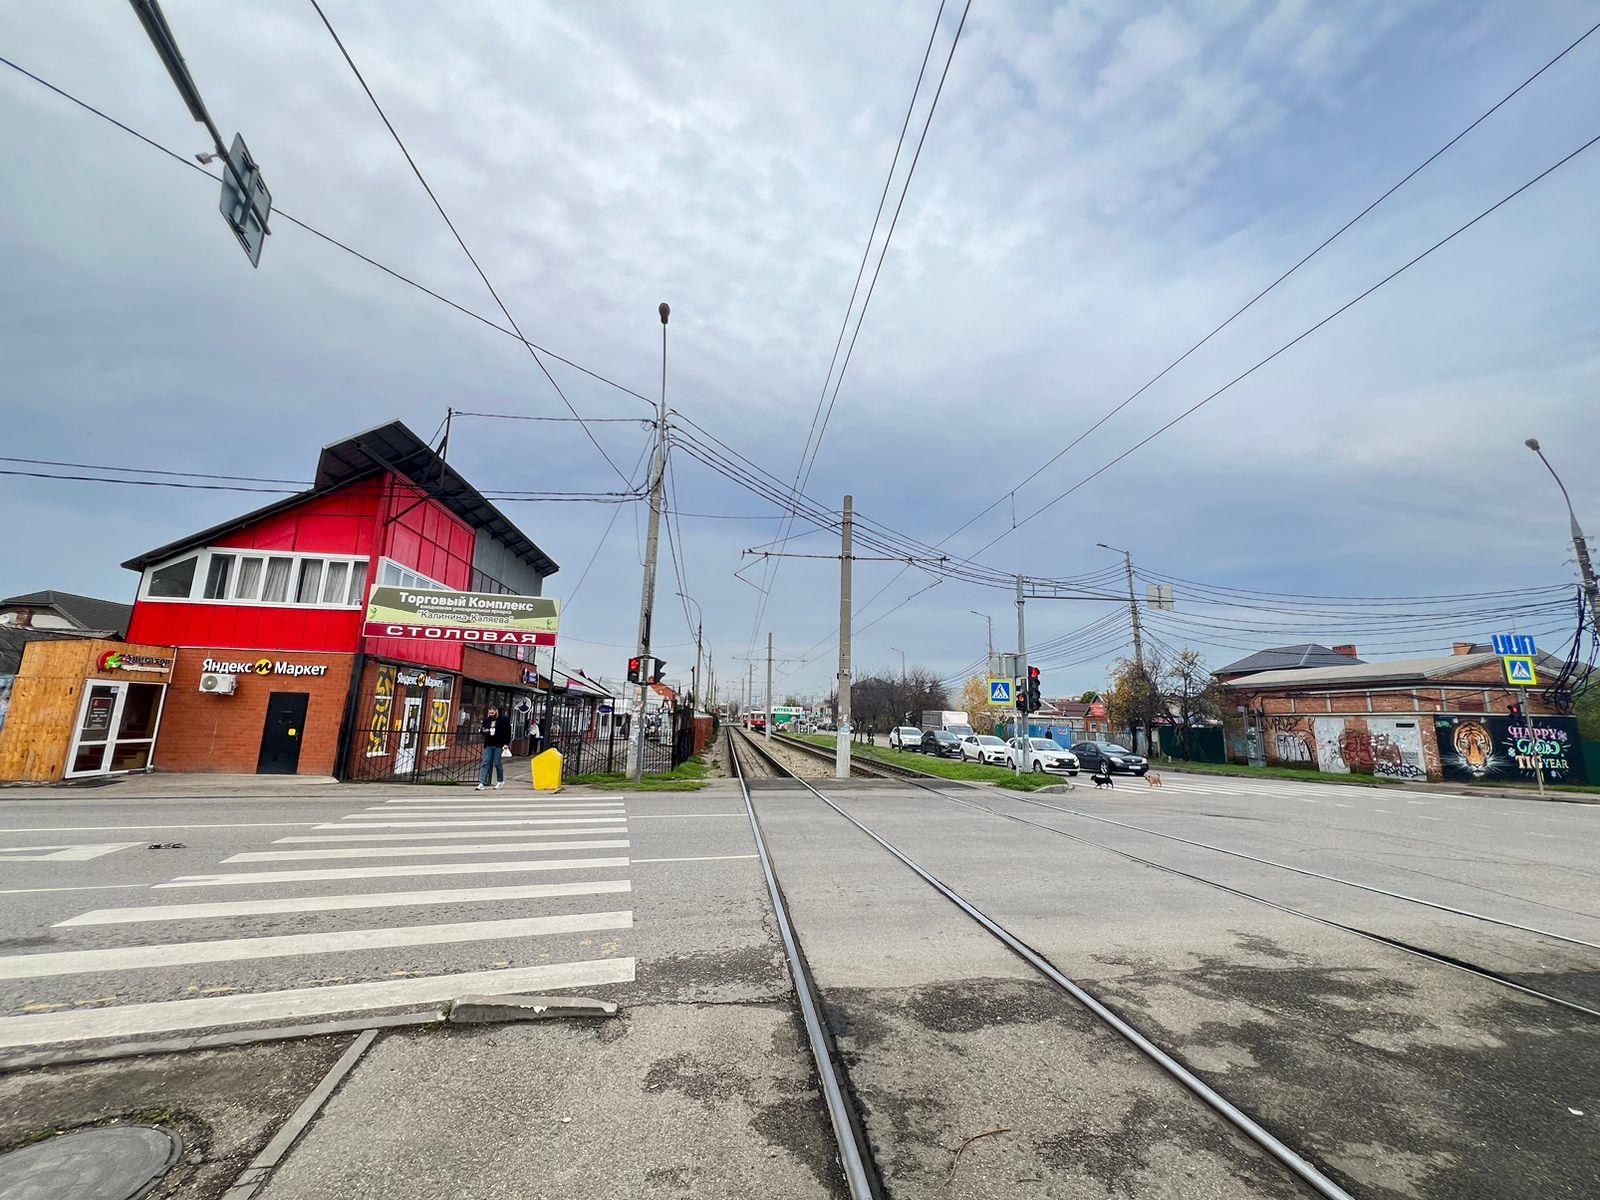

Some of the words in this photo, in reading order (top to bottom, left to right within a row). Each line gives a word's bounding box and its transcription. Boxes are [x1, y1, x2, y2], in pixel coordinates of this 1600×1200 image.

[399, 592, 468, 608] Торговый
[469, 597, 534, 611] Комплекс
[386, 625, 537, 643] СТОЛОВАЯ
[202, 658, 253, 674] Яндекс
[274, 661, 327, 677] Маркет
[1508, 725, 1557, 740] HAPPY
[1542, 758, 1569, 769] YEAR
